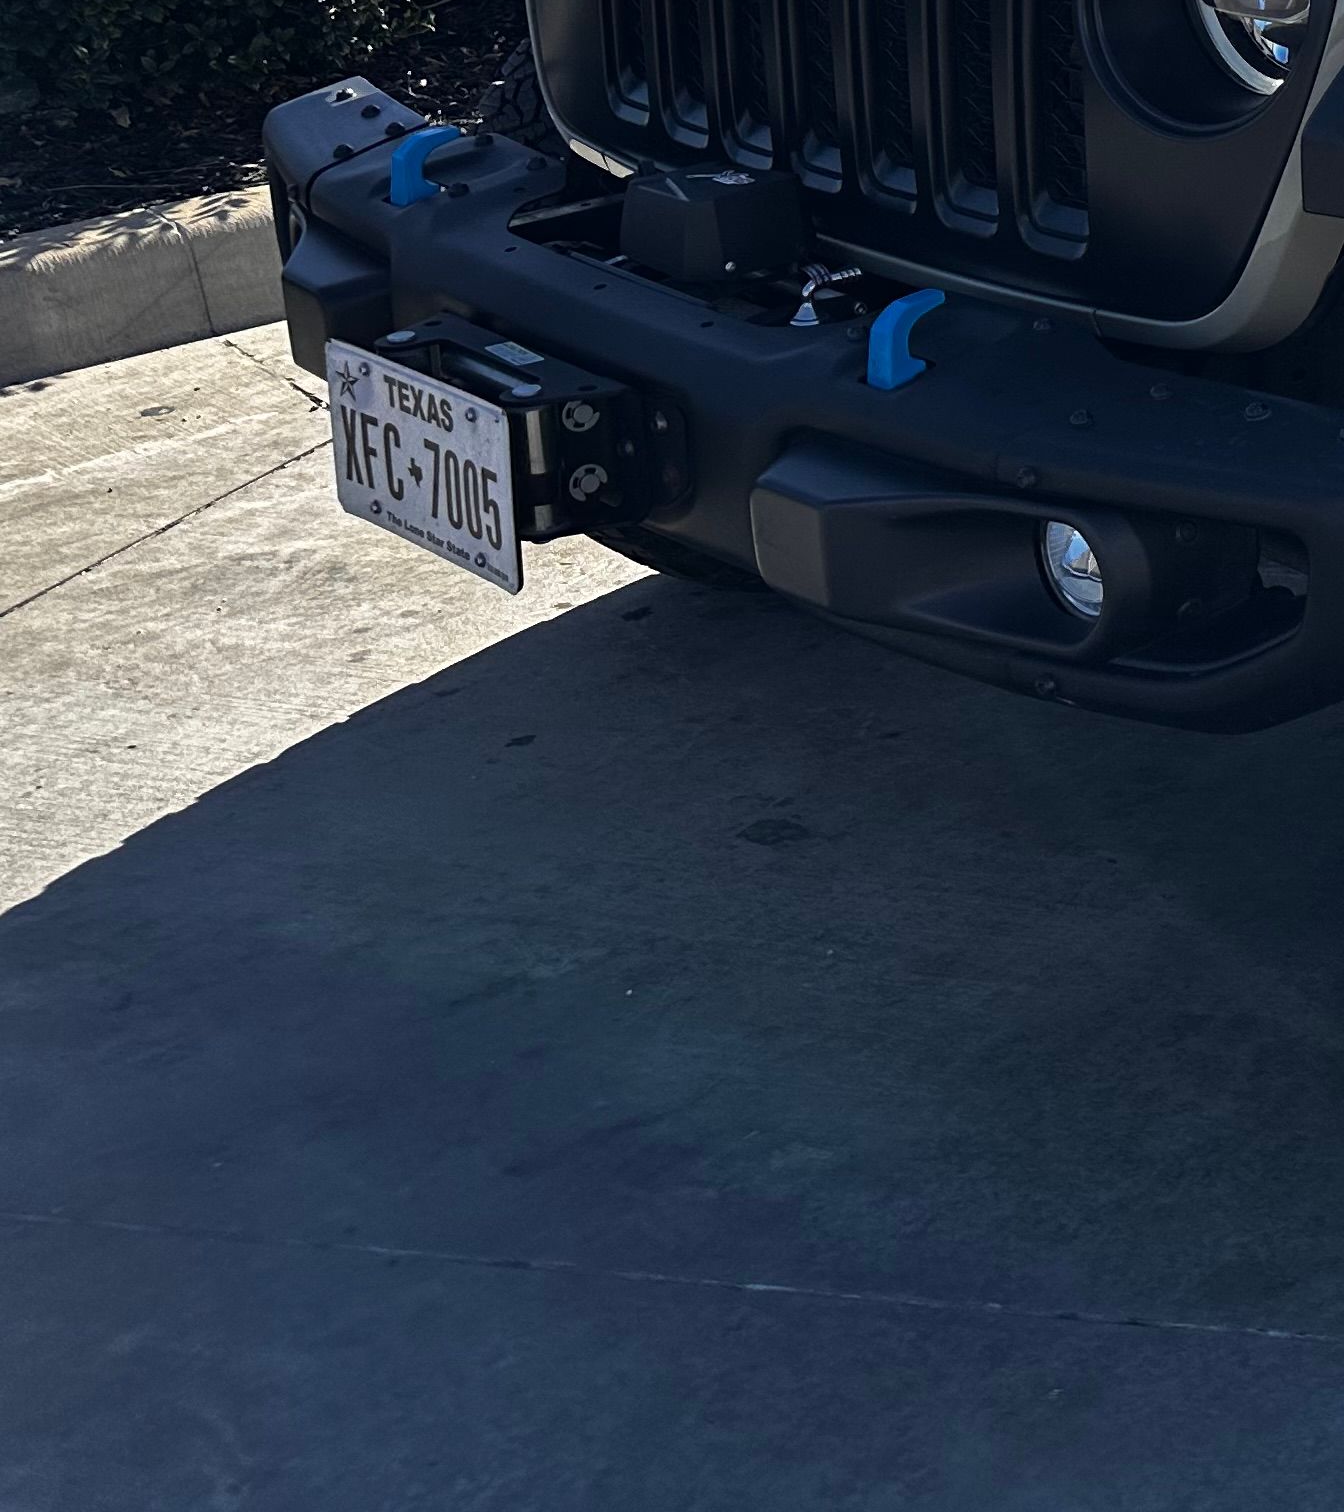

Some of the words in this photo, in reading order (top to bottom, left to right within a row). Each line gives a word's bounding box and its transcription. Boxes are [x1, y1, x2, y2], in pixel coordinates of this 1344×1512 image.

[383, 374, 454, 433] TEXAS
[386, 510, 402, 527] The
[404, 519, 425, 538] Lone
[426, 530, 445, 548] Star
[446, 540, 471, 561] State
